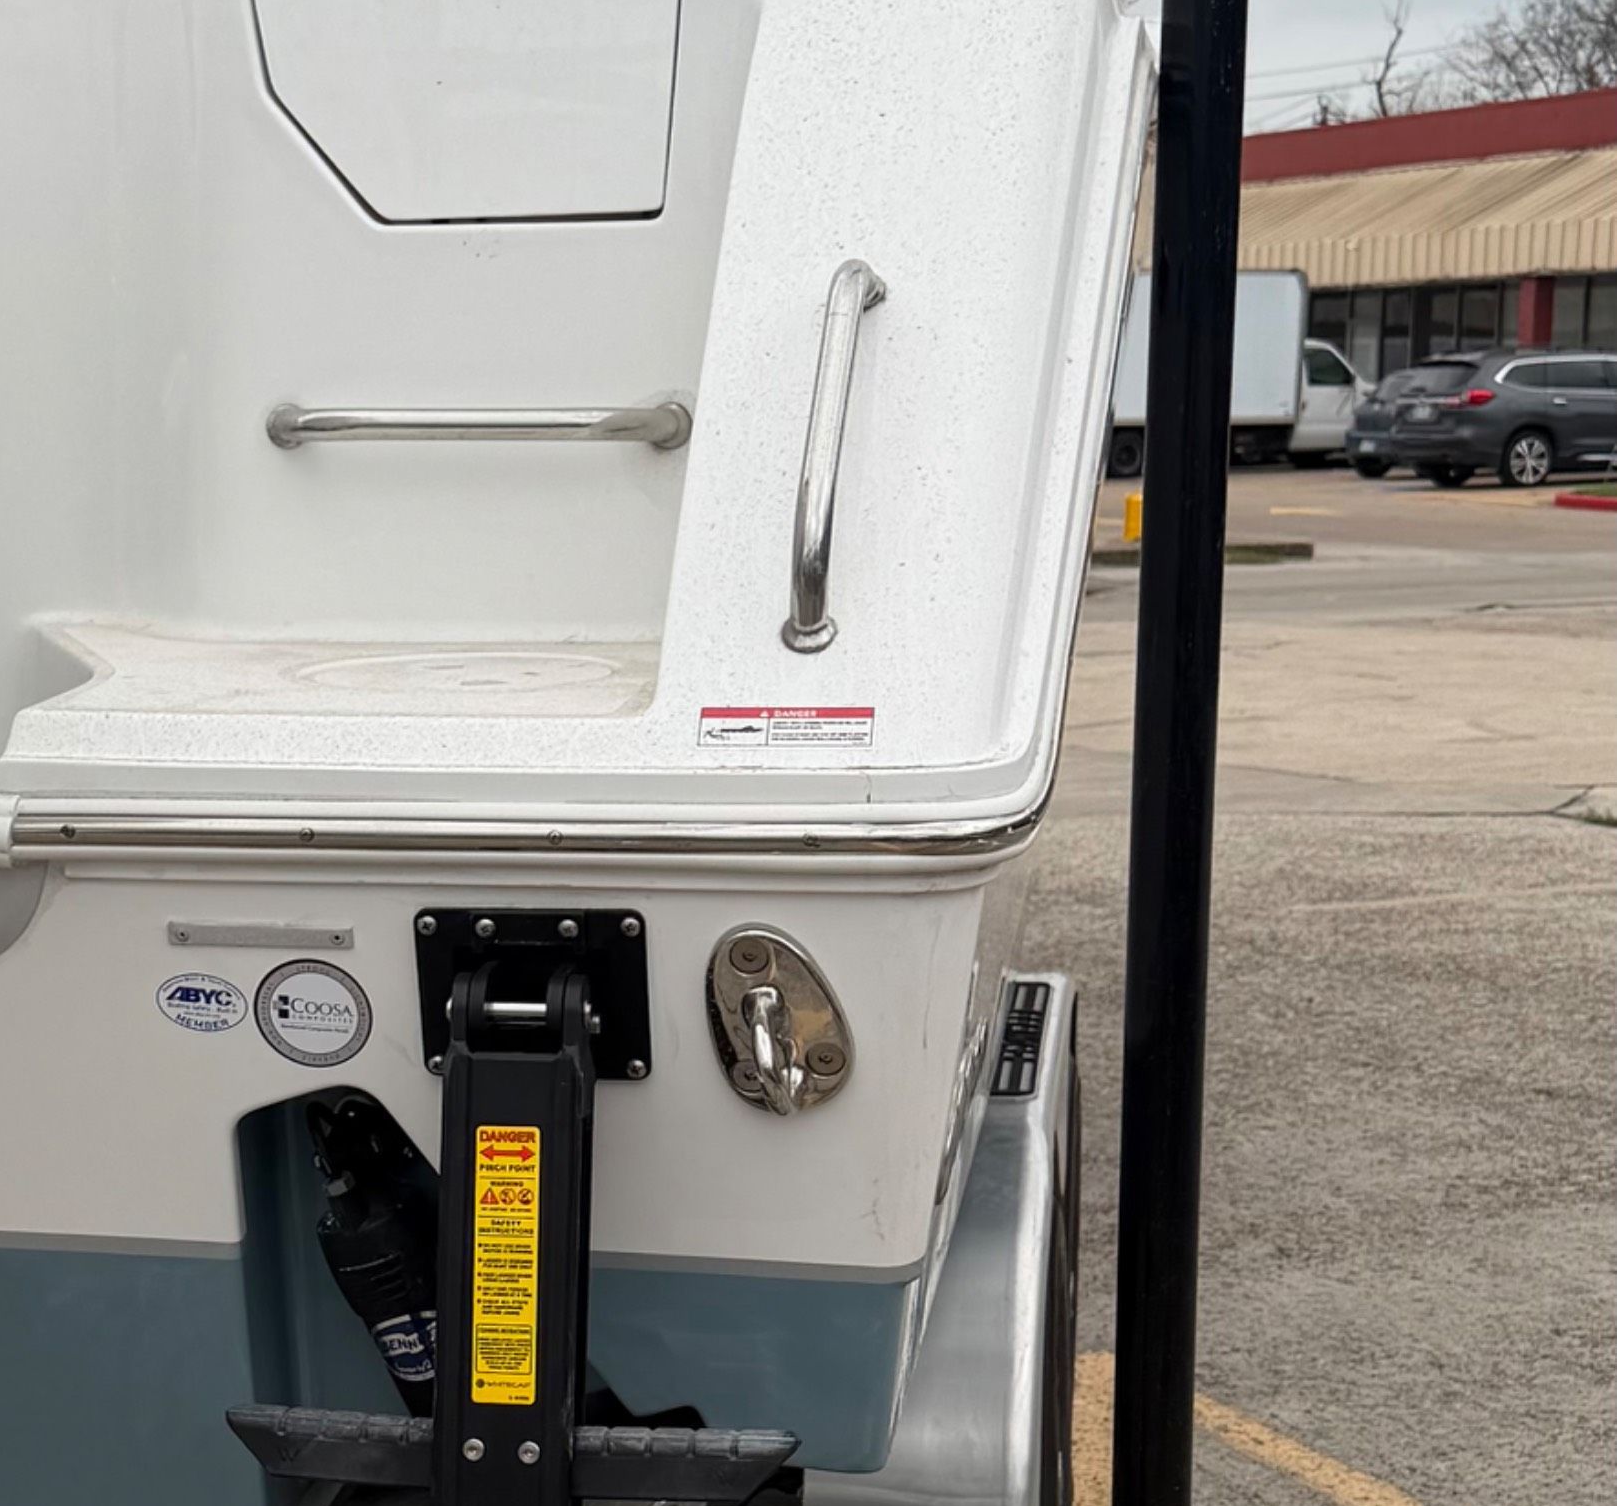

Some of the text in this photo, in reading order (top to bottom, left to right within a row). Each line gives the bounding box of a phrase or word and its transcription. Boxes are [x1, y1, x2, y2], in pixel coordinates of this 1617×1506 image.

[774, 709, 817, 718] DANGER
[165, 986, 232, 1006] ABYC
[291, 997, 354, 1017] COOSA
[479, 1130, 536, 1143] DANGER
[508, 1164, 535, 1173] POINT
